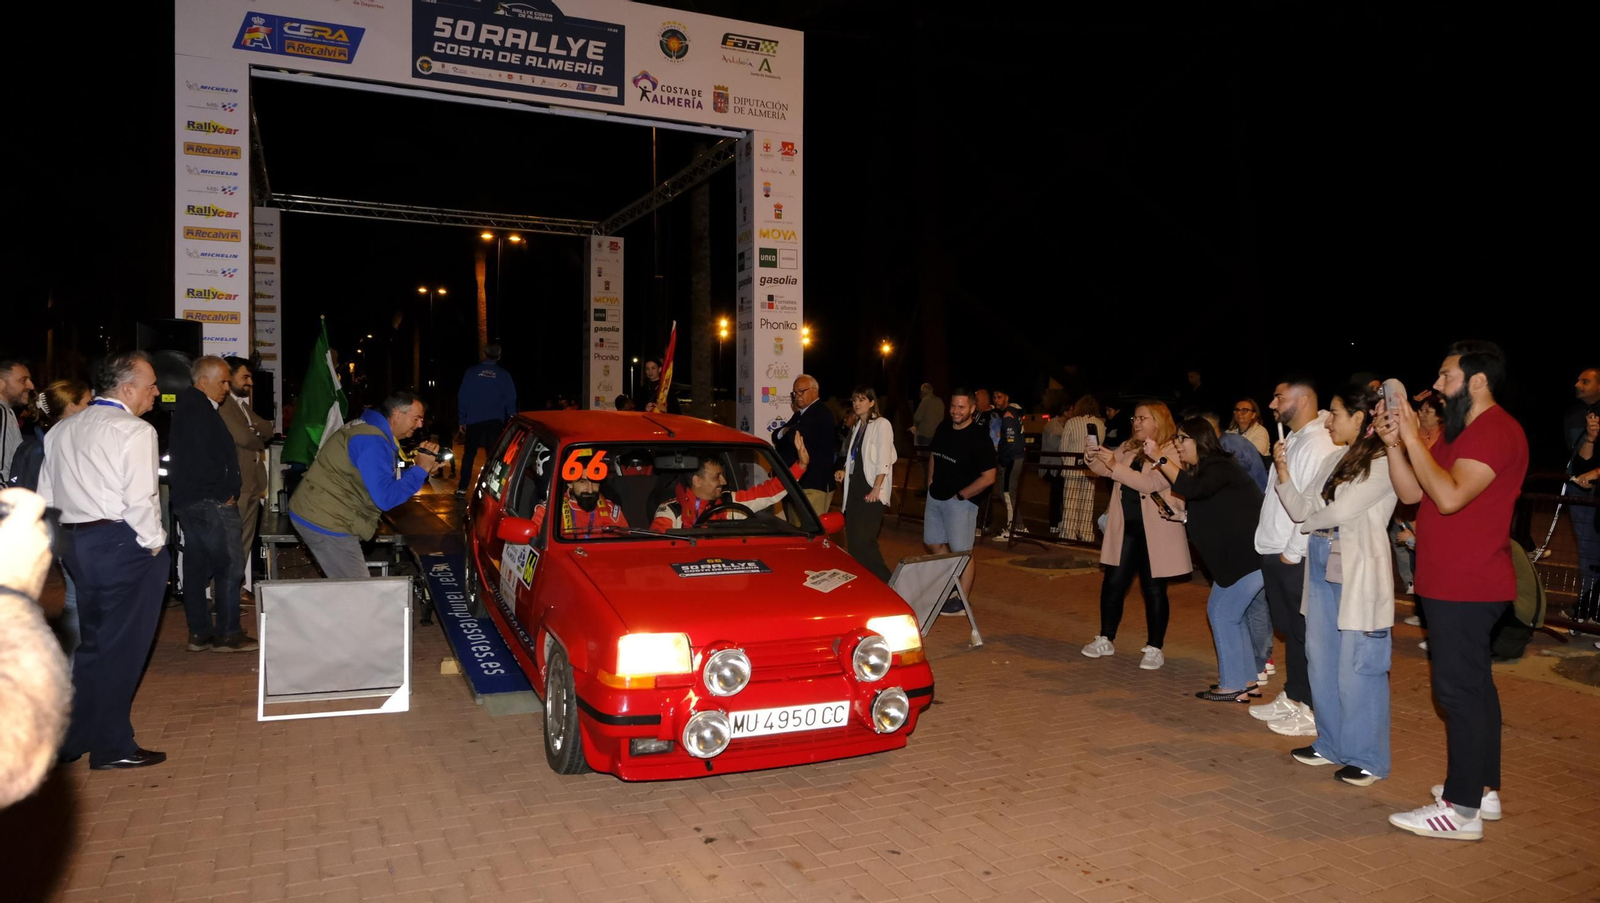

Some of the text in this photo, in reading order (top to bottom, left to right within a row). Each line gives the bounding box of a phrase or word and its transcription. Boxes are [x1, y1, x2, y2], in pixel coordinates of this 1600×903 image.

[283, 22, 350, 42] CERA
[433, 16, 608, 61] 50 RALLYE
[296, 43, 337, 58] Recalvi
[433, 40, 604, 76] COSTA DE ALMERÍA
[200, 84, 238, 94] MICHELIN
[660, 84, 702, 98] COSTA DE
[652, 94, 704, 110] ALMERÍA
[733, 96, 789, 112] DIPUTACIÓN
[733, 106, 786, 121] DE ALMERÍA
[187, 120, 239, 136] Rallycar
[195, 145, 230, 156] Recalvi
[200, 169, 238, 177] MICHELIN
[187, 204, 239, 218] Rallycar
[195, 230, 230, 240] Recalvi
[758, 228, 798, 241] MOYA
[760, 276, 798, 286] gasolia
[186, 288, 239, 301] Rallycar
[194, 311, 229, 322] Recalvi
[760, 318, 798, 330] Phonika
[594, 353, 620, 361] Phonika
[562, 448, 608, 480] 66
[700, 562, 756, 570] RALLYE
[732, 704, 846, 735] MU 4950 CC
